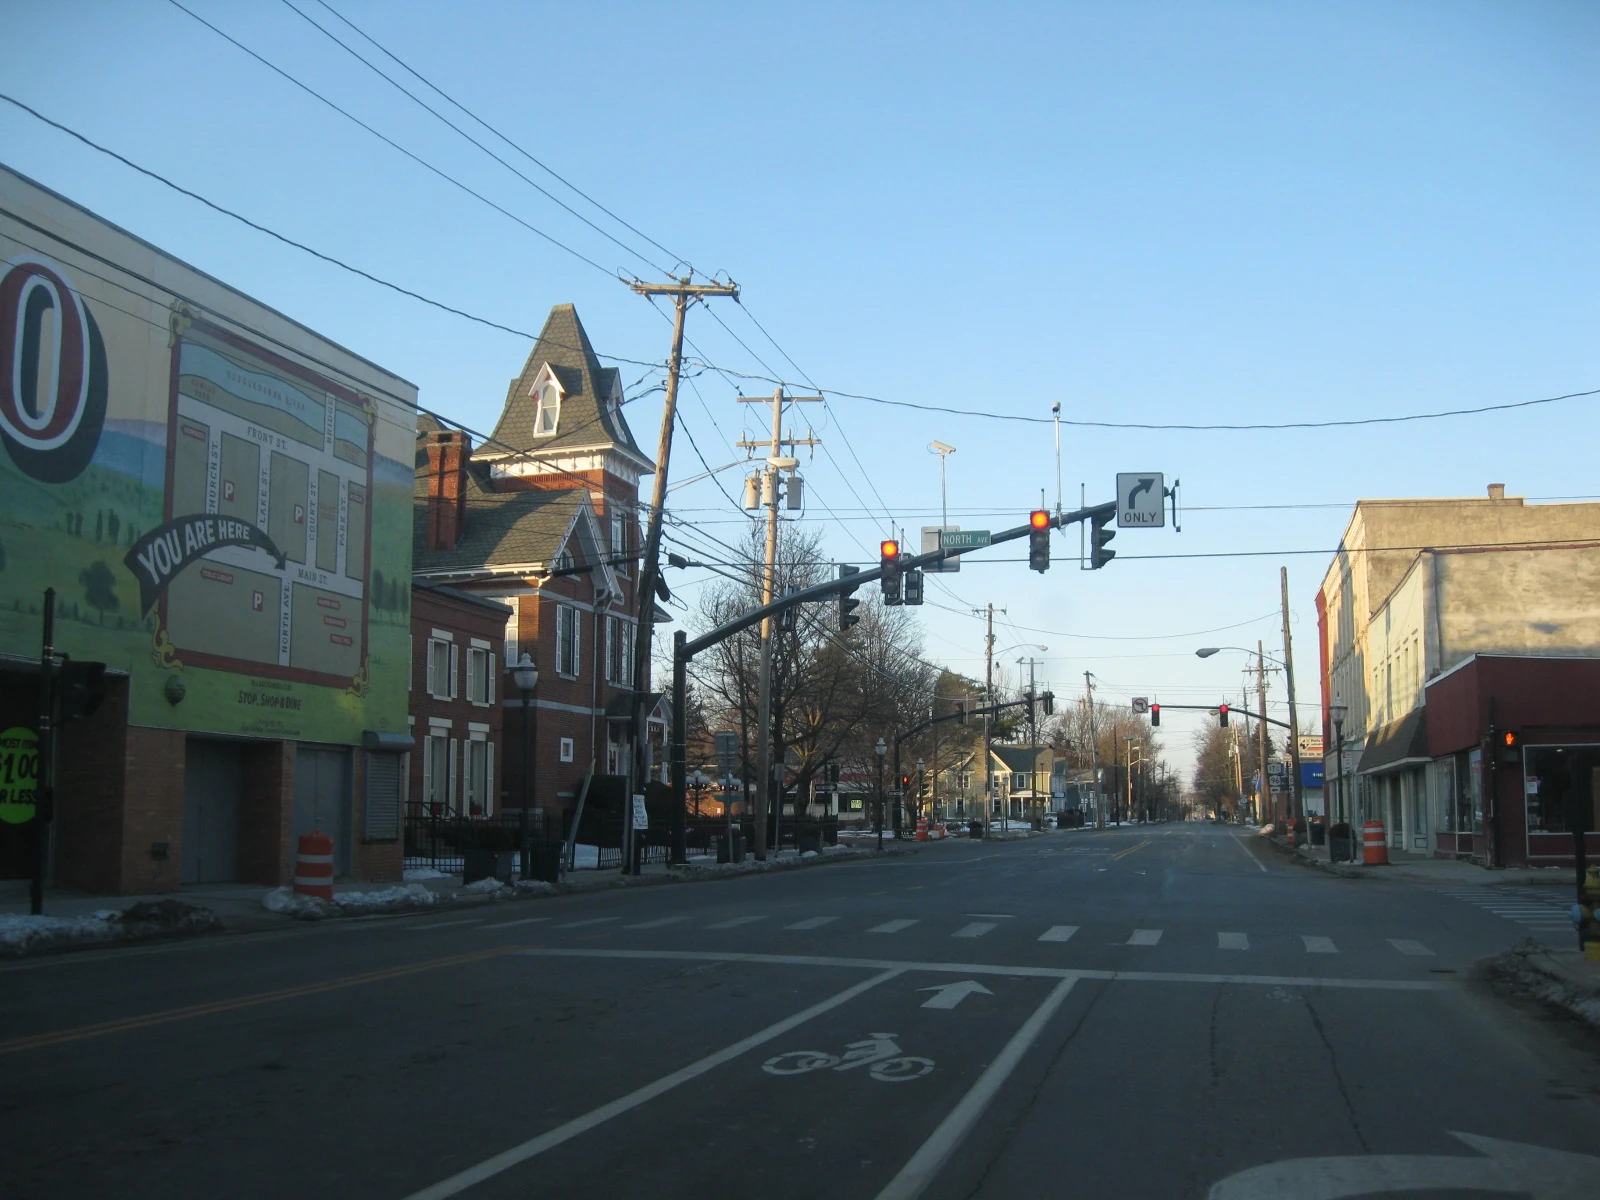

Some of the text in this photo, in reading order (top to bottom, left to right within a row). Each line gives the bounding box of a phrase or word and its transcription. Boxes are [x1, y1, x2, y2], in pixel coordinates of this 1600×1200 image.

[247, 426, 288, 450] FRONT ST.
[208, 441, 219, 515] CHURCH ST.
[225, 482, 234, 498] P
[259, 490, 267, 524] LAKE
[295, 506, 303, 522] P
[308, 500, 316, 541] COURT
[1124, 512, 1157, 523] ONLY
[943, 534, 988, 545] NORTH AVE
[137, 519, 250, 585] YOU ARE HERE
[298, 568, 329, 585] MAIN ST.
[254, 592, 263, 609] P
[281, 612, 289, 653] NORTH
[238, 690, 259, 706] STOP,
[260, 693, 279, 708] SHOP
[285, 696, 302, 710] DINE
